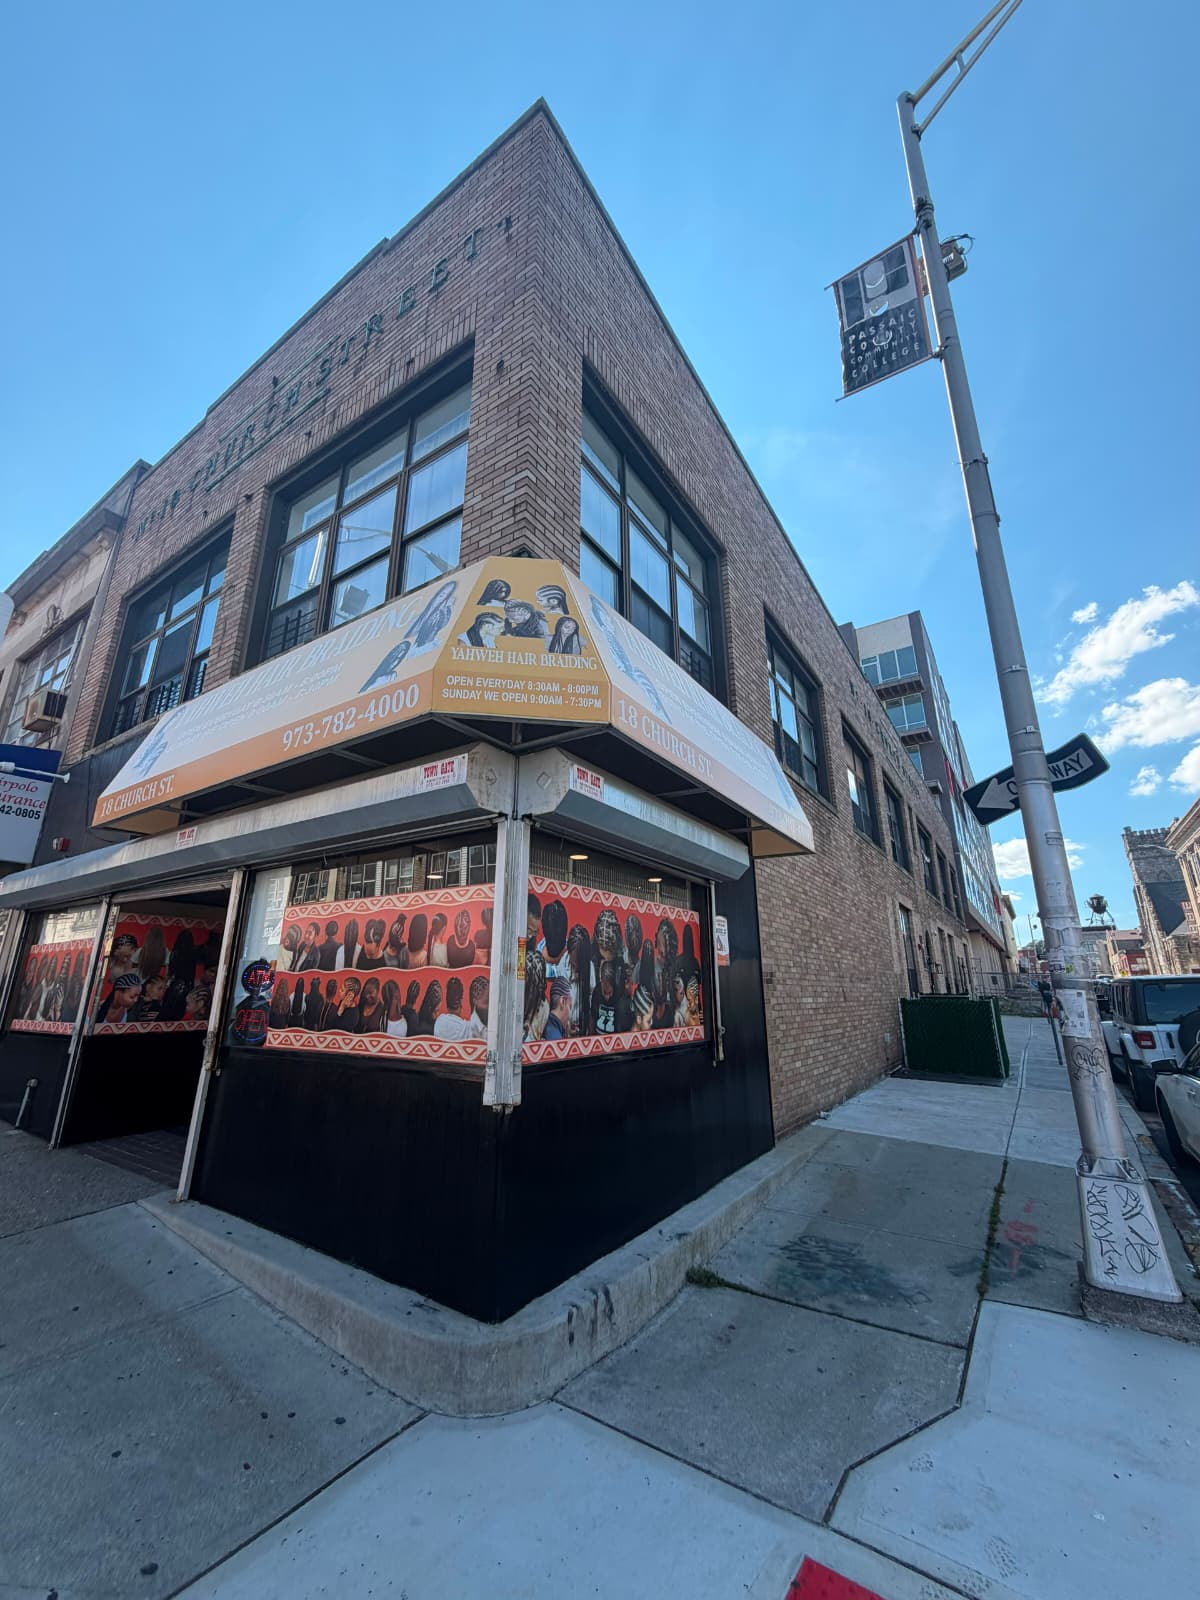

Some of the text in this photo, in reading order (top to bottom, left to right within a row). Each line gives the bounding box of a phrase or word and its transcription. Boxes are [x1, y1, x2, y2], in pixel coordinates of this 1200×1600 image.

[315, 227, 482, 387] STREET
[849, 308, 915, 345] PASSAIC
[850, 331, 919, 364] COMMUNITY
[851, 342, 920, 378] COLLEGE
[451, 647, 598, 670] YAHWEH HAIR BRAIDING
[442, 688, 482, 700] SUNDAY
[484, 691, 499, 701] WE
[501, 692, 528, 703] OPEN
[530, 694, 562, 705] 9:00AM
[570, 697, 602, 709] 7:30PM
[446, 675, 473, 686] OPEN
[476, 678, 526, 690] EVERYDAY
[527, 681, 560, 692] 8:30AM
[567, 684, 599, 695] 8:00PM
[282, 683, 419, 751] 973-782-4000
[617, 699, 714, 779] 18 CHURCH ST.
[1048, 752, 1085, 779] WAY
[101, 775, 175, 817] 18 CHURCH ST.
